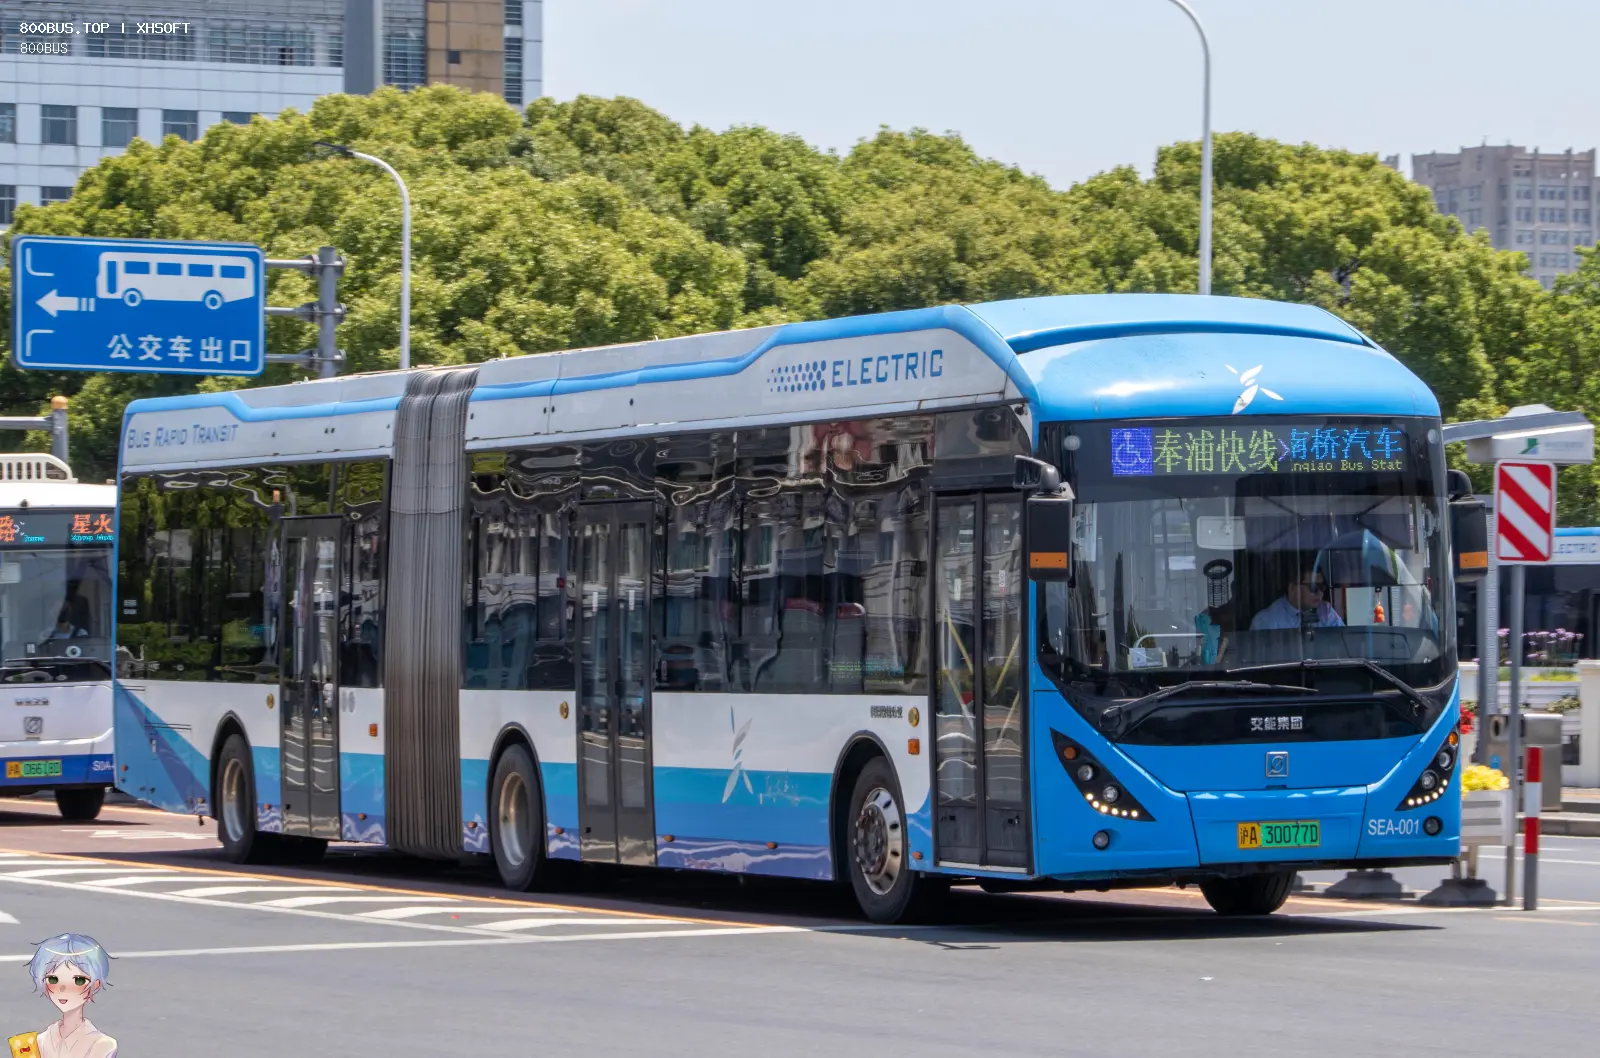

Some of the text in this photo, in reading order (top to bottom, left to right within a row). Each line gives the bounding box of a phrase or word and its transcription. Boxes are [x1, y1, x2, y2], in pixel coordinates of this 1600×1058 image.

[106, 333, 252, 363] 公交车出口
[831, 349, 943, 388] ELECTRIC
[1153, 429, 1278, 472] 奉浦快线
[1291, 459, 1403, 472] nqiao Bus Stat
[72, 513, 114, 534] 星火
[1240, 824, 1318, 845] 沪A 30077D
[1367, 818, 1420, 836] SEA-001
